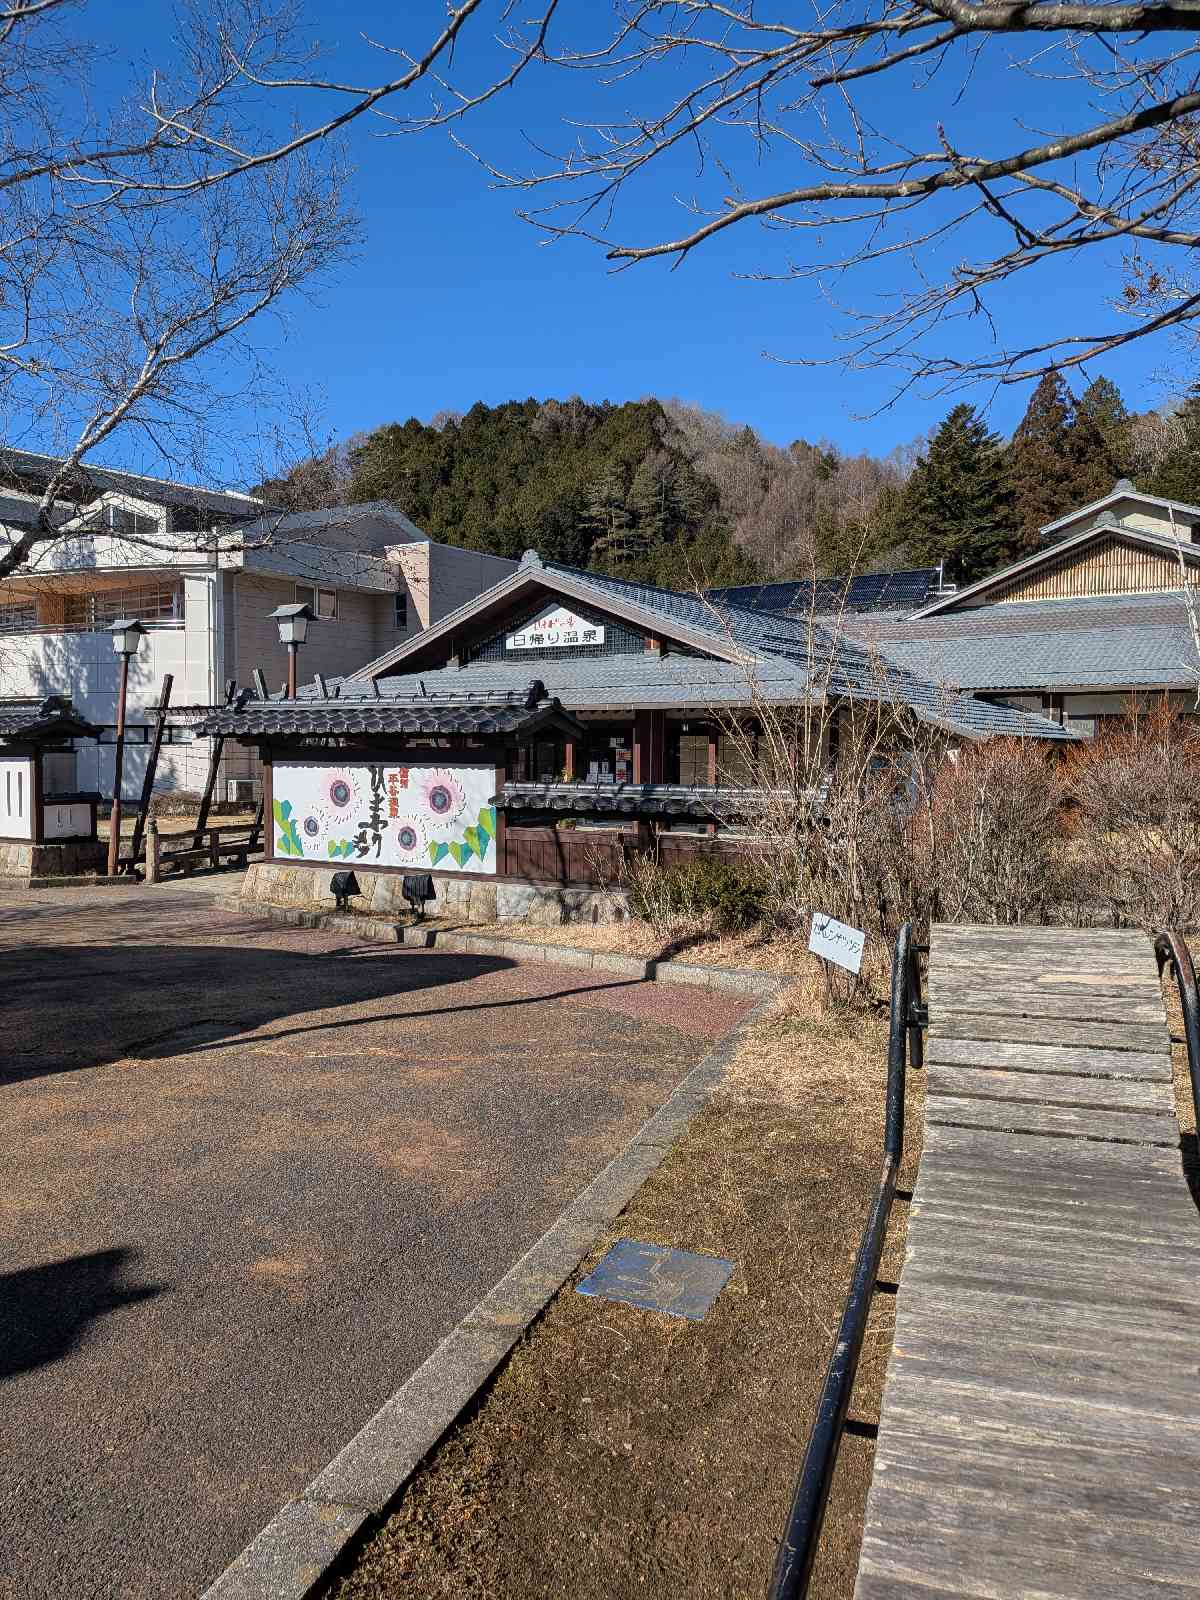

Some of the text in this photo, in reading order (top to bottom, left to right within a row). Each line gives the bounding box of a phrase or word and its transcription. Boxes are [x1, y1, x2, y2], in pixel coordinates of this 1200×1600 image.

[513, 629, 598, 647] 日帰り温泉
